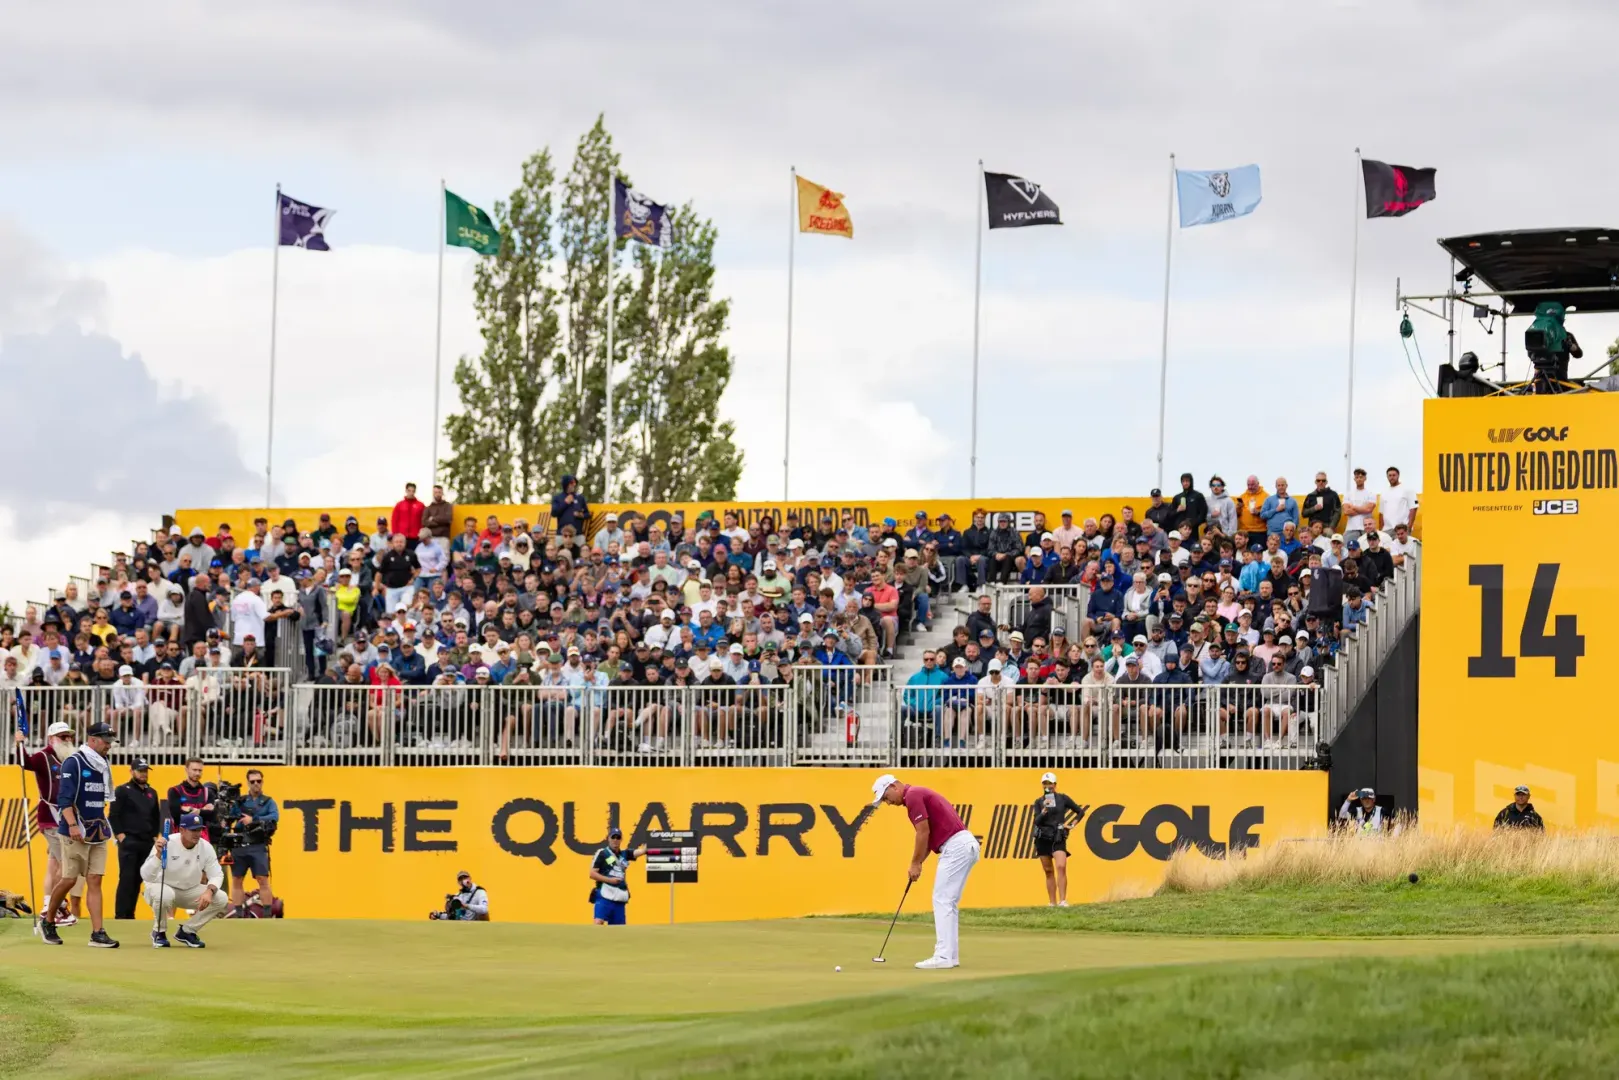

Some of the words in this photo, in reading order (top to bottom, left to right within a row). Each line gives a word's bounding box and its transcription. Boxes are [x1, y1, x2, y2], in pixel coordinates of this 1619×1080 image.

[1003, 209, 1057, 221] HYFLYERS
[1523, 426, 1569, 442] GOLF
[1438, 452, 1511, 492] UNITED
[1515, 449, 1618, 491] KINGDOM
[1533, 499, 1579, 515] JCB
[1467, 563, 1585, 678] 14
[283, 799, 458, 853] THE
[491, 797, 878, 866] QUARRY
[1084, 803, 1265, 862] GOLF
